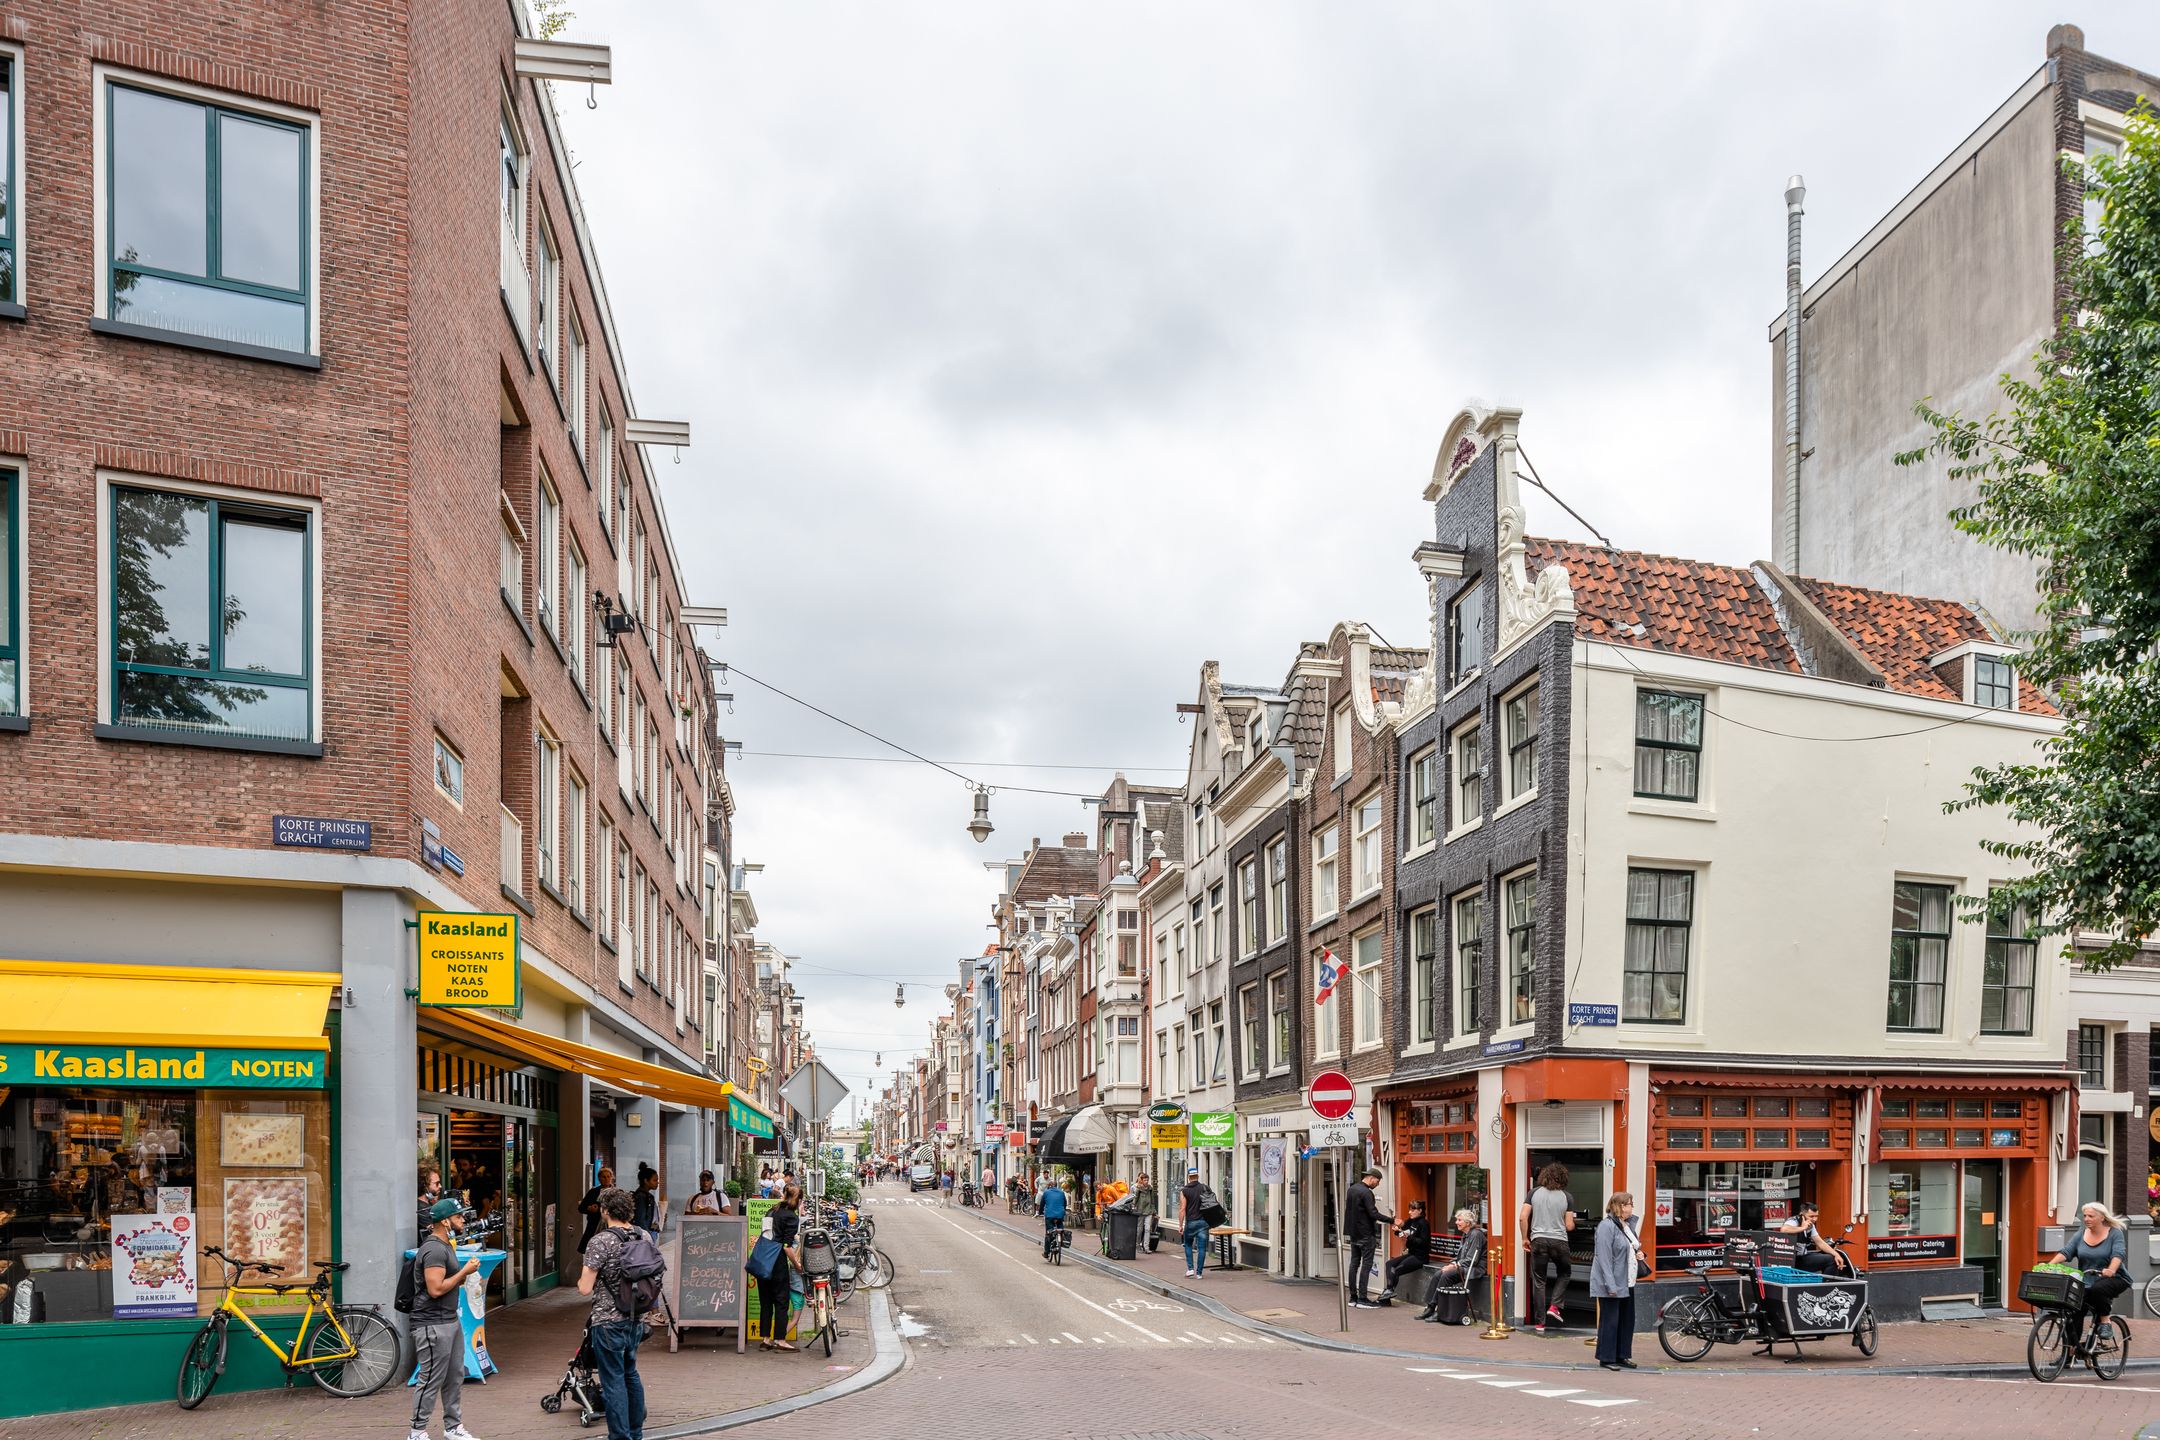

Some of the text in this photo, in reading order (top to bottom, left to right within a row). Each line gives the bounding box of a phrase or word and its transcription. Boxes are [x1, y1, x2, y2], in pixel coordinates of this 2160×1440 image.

[279, 818, 365, 835] KORTE PRINSEN
[279, 831, 365, 847] GRACHT CENTRUM
[428, 921, 508, 937] Kaasland
[431, 950, 504, 960] CROISSANTS
[447, 964, 488, 974] NOTEN
[451, 976, 484, 986] KAAS
[445, 988, 489, 998] BROOD
[1572, 1005, 1617, 1015] KORTE PRINSEN
[34, 1049, 205, 1080] Kaasland
[231, 1059, 313, 1078] NOTEN
[1150, 1109, 1181, 1118] SUBWAY
[1130, 1120, 1147, 1130] Nails
[1311, 1122, 1357, 1131] uitgezonderd
[1896, 1241, 1919, 1249] Delivery
[1922, 1240, 1945, 1248] Catering
[1678, 1248, 1716, 1257] Take-away
[135, 1294, 177, 1302] FRANKRIJK
[709, 1289, 736, 1313] 4.95
